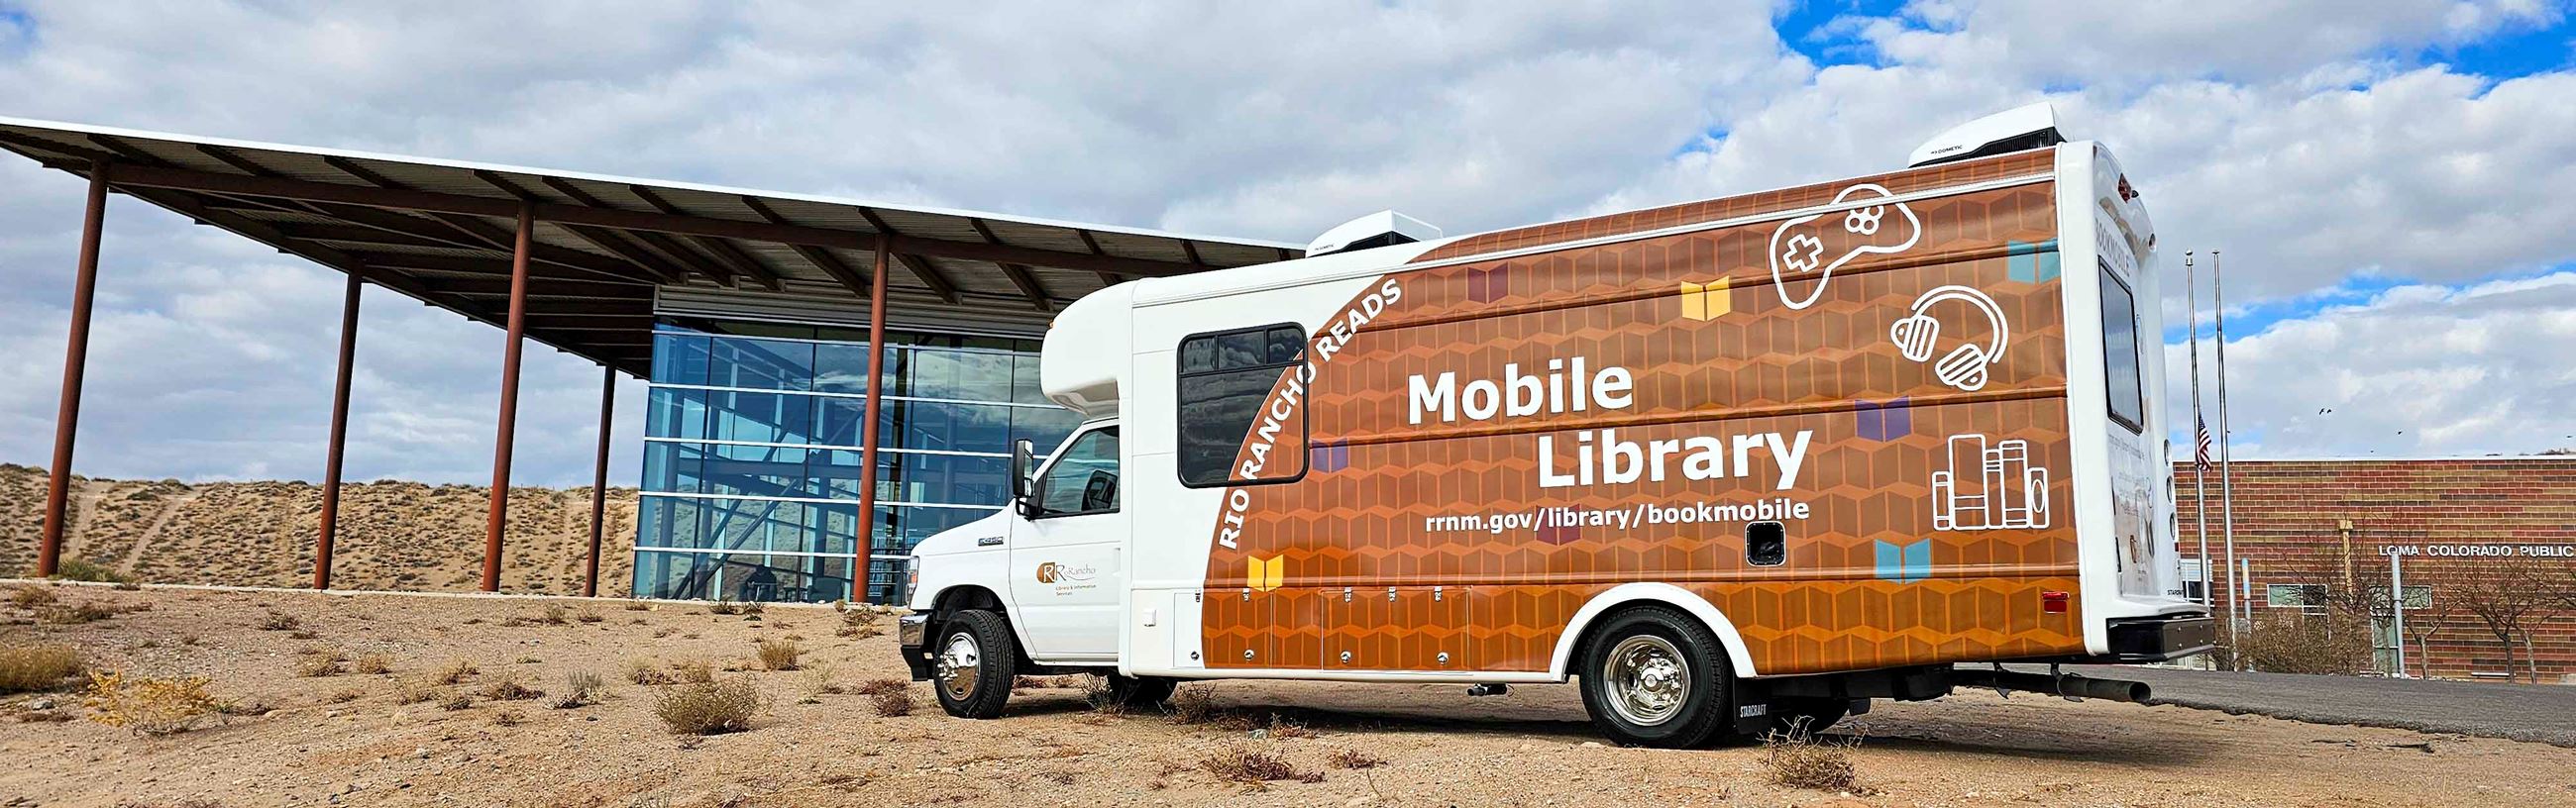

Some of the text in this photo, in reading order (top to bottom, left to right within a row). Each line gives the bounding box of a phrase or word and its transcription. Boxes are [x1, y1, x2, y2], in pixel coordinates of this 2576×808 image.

[1219, 278, 1402, 550] RIO RANCHO READS
[1408, 356, 1633, 425] Mobile
[1538, 429, 1813, 490] Library
[1425, 498, 1810, 533] rrnm.gov/library/bookmobile
[2378, 545, 2575, 556] LOMA COLORADO PUBLIC
[1740, 704, 1767, 718] STARCRAFT
